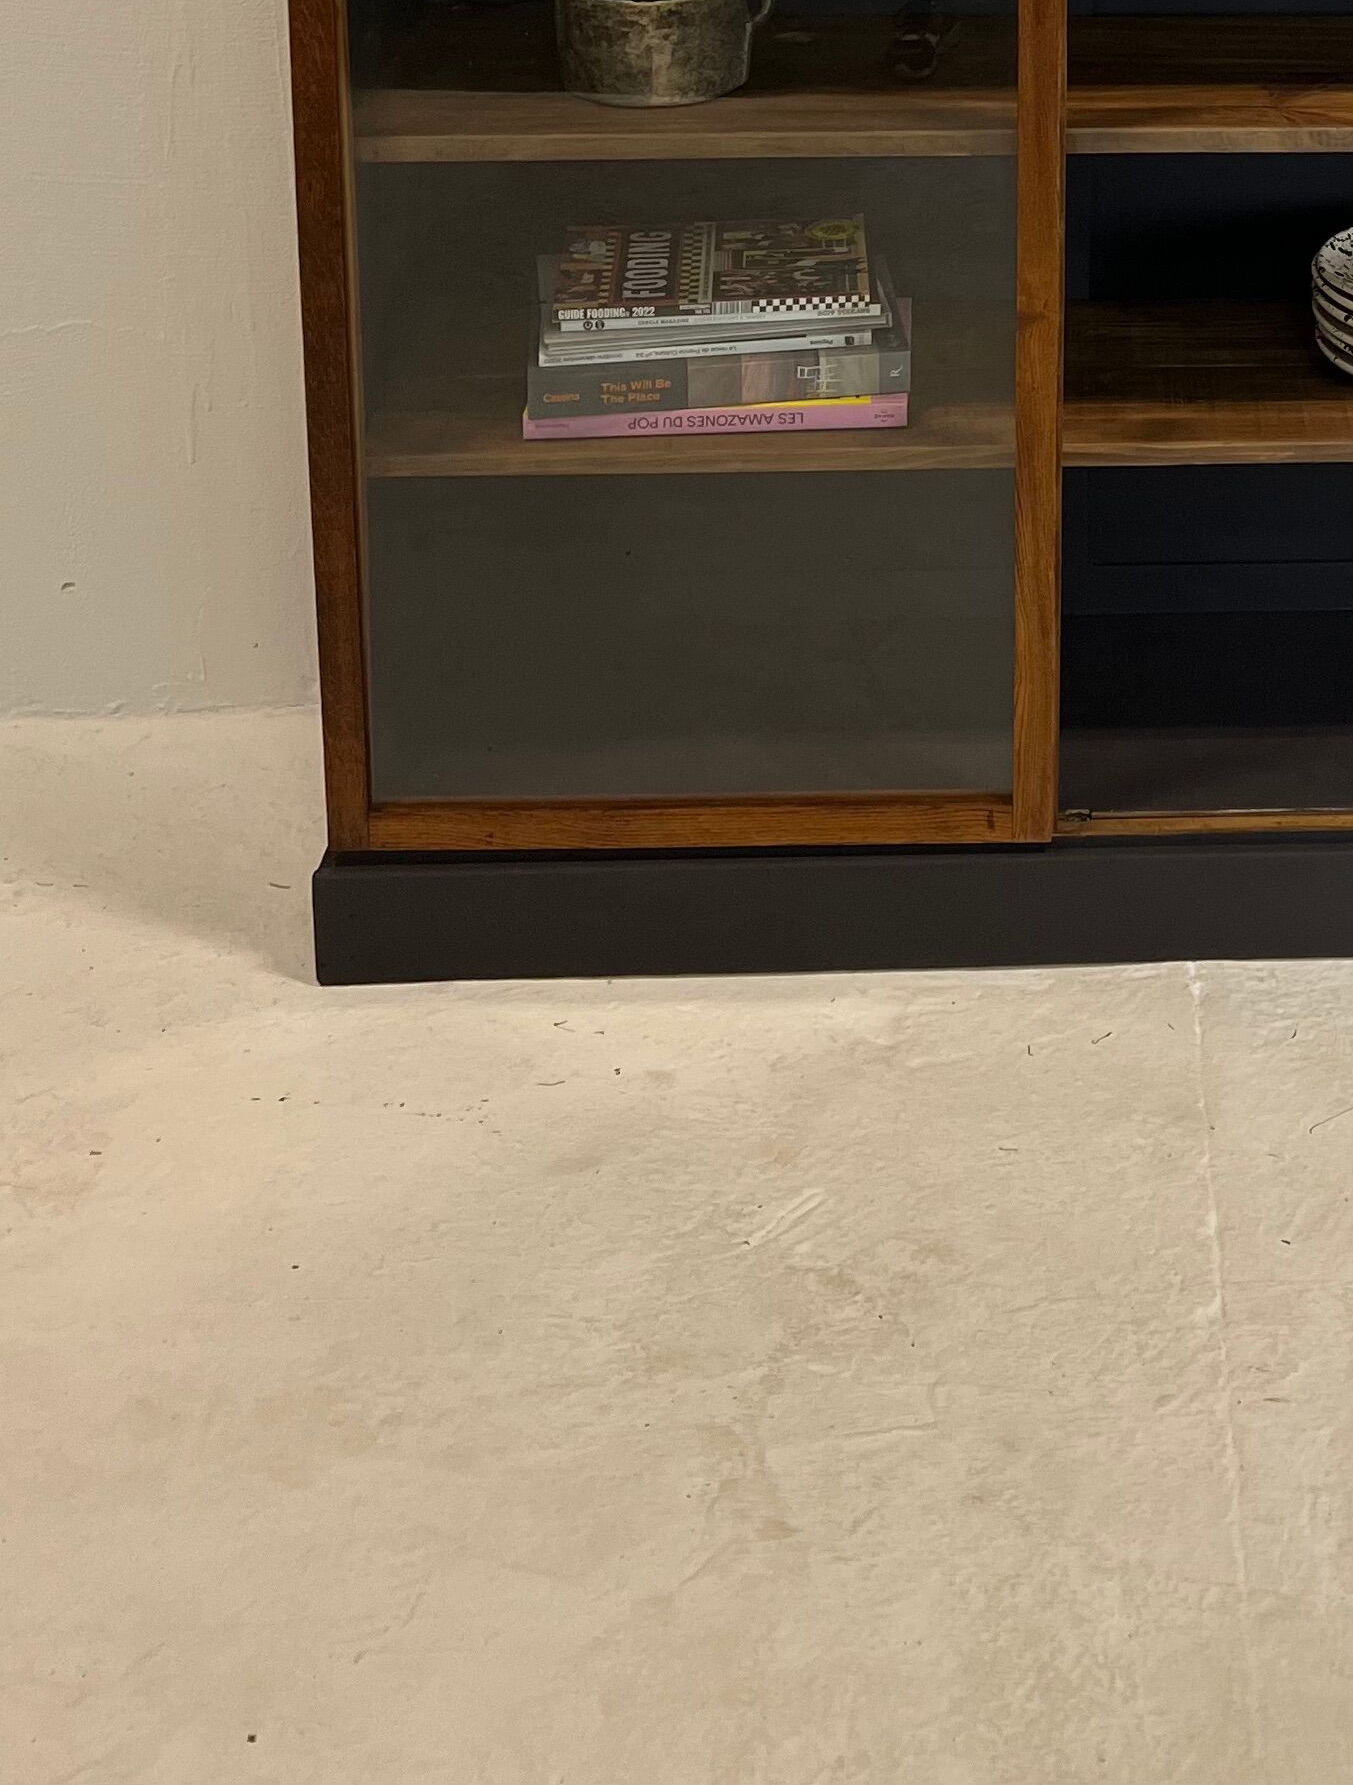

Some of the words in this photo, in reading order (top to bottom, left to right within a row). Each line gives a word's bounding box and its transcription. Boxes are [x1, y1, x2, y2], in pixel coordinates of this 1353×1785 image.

[621, 230, 672, 298] FOODING
[558, 309, 584, 320] GUIDE
[632, 306, 655, 317] 2022
[600, 382, 627, 392] This
[630, 379, 653, 389] Will
[655, 378, 672, 389] Be
[600, 394, 625, 404] The
[628, 392, 661, 403] Place
[627, 417, 658, 430] POP
[662, 416, 683, 428] DU
[687, 413, 774, 427] AMAZONES
[778, 412, 804, 424] LES
